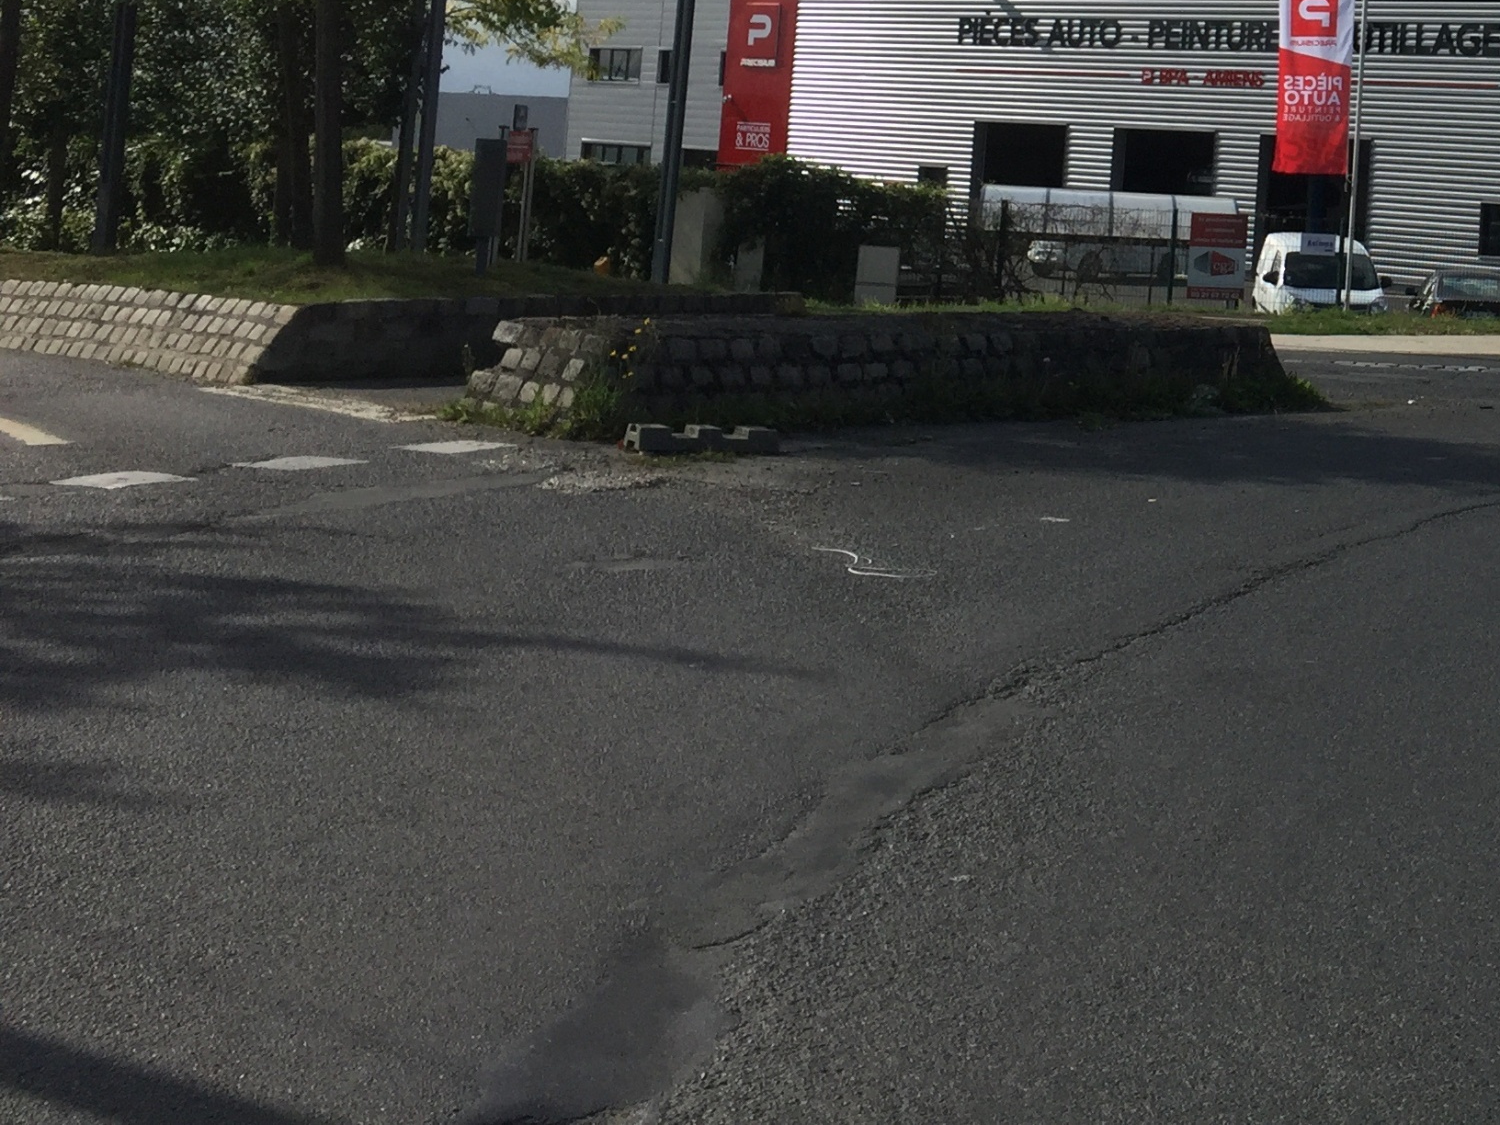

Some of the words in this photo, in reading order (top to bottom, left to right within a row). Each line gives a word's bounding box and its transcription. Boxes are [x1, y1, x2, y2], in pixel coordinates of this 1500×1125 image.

[958, 9, 1040, 47] PIÈCES
[1050, 17, 1118, 49] AUTO
[1148, 20, 1280, 53] PEINTURE
[1353, 21, 1500, 58] UTILLAGE
[1203, 69, 1266, 88] AMIENS
[745, 133, 770, 149] PROS
